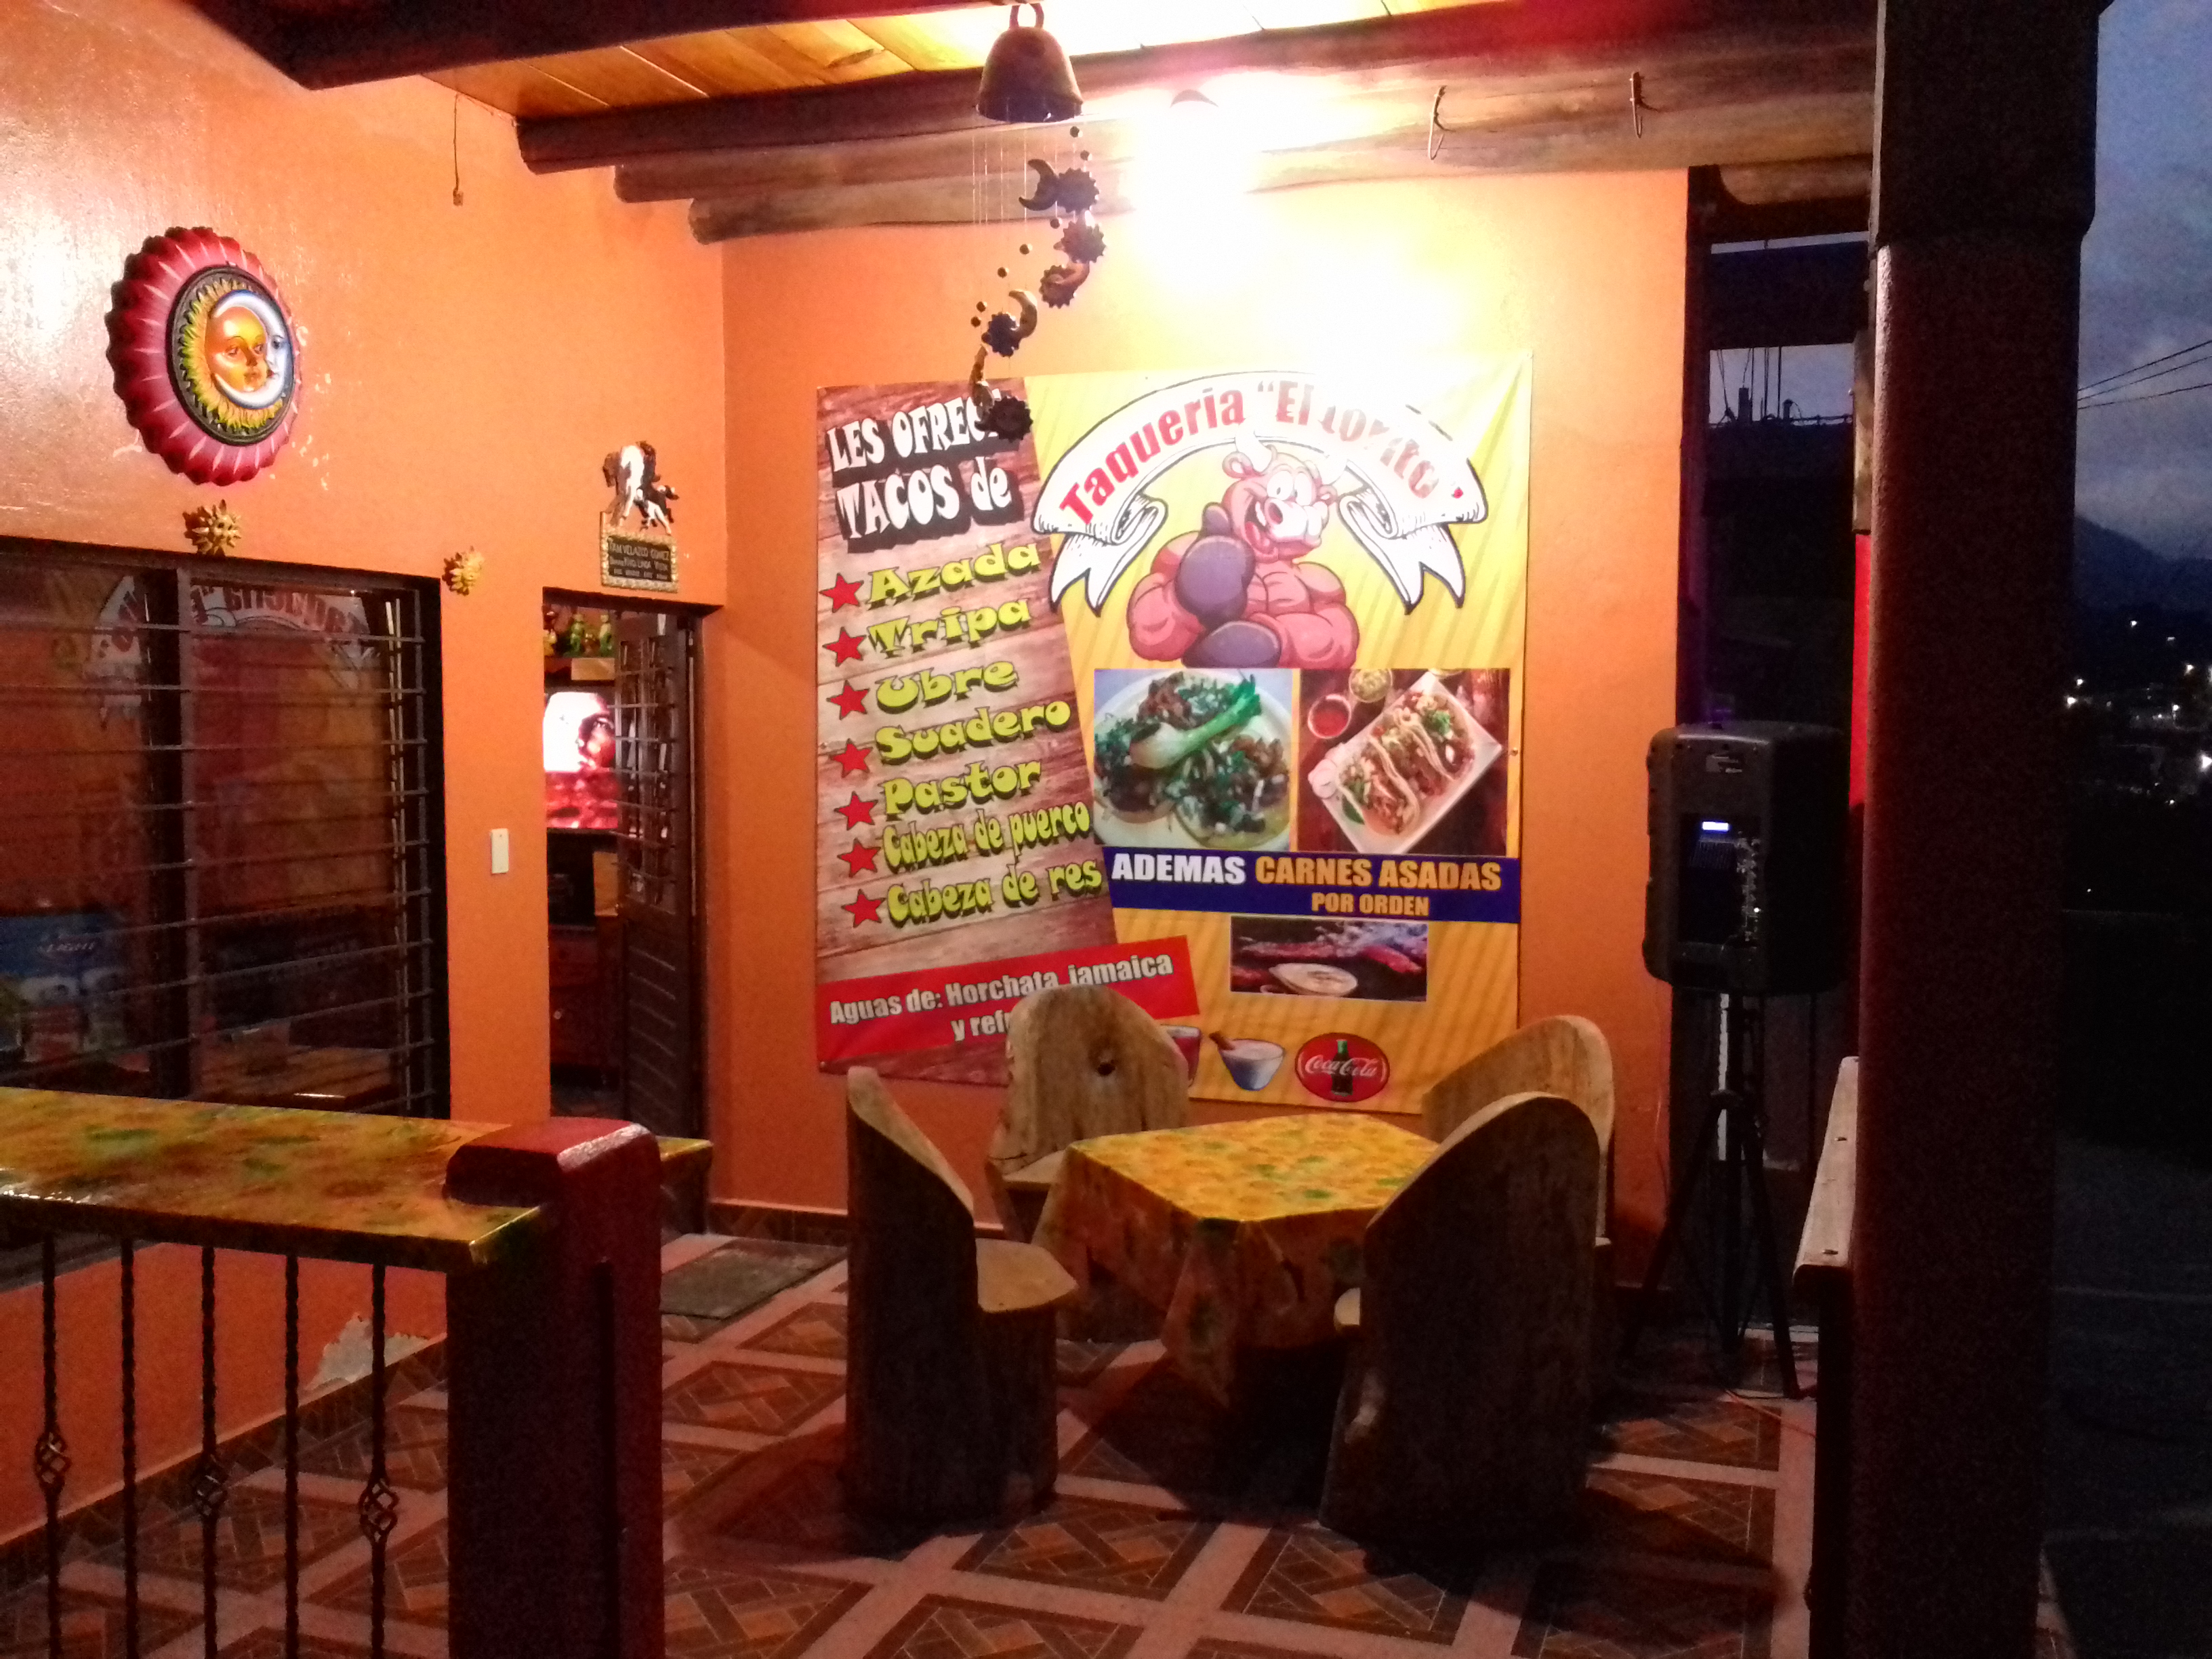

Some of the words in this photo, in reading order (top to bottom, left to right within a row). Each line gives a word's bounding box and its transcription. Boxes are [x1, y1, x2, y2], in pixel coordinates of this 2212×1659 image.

[826, 417, 885, 472] LES
[891, 388, 1001, 458] OFREC
[836, 464, 961, 539] TACOS
[970, 456, 1013, 512] de
[868, 541, 1042, 609] Azada
[867, 598, 1031, 657] Tripa
[874, 661, 1019, 714] Ubre
[874, 701, 1071, 764] Suadero
[880, 760, 1042, 819] Pastor
[882, 821, 968, 874] Cabeza
[974, 808, 1004, 857] de
[1008, 800, 1091, 861] puerco
[886, 878, 994, 928] Cabeza
[1002, 862, 1040, 907] de
[1046, 858, 1103, 901] res
[1111, 853, 1247, 885] ADEMAS
[1254, 855, 1372, 887] CARNES
[1378, 859, 1502, 891] ASADAS
[1311, 891, 1354, 914] POR
[1358, 893, 1429, 916] ORDEN
[829, 995, 903, 1025] Aguas
[905, 988, 943, 1013] de:
[945, 970, 1059, 1007] Horchata
[950, 1018, 966, 1042] y
